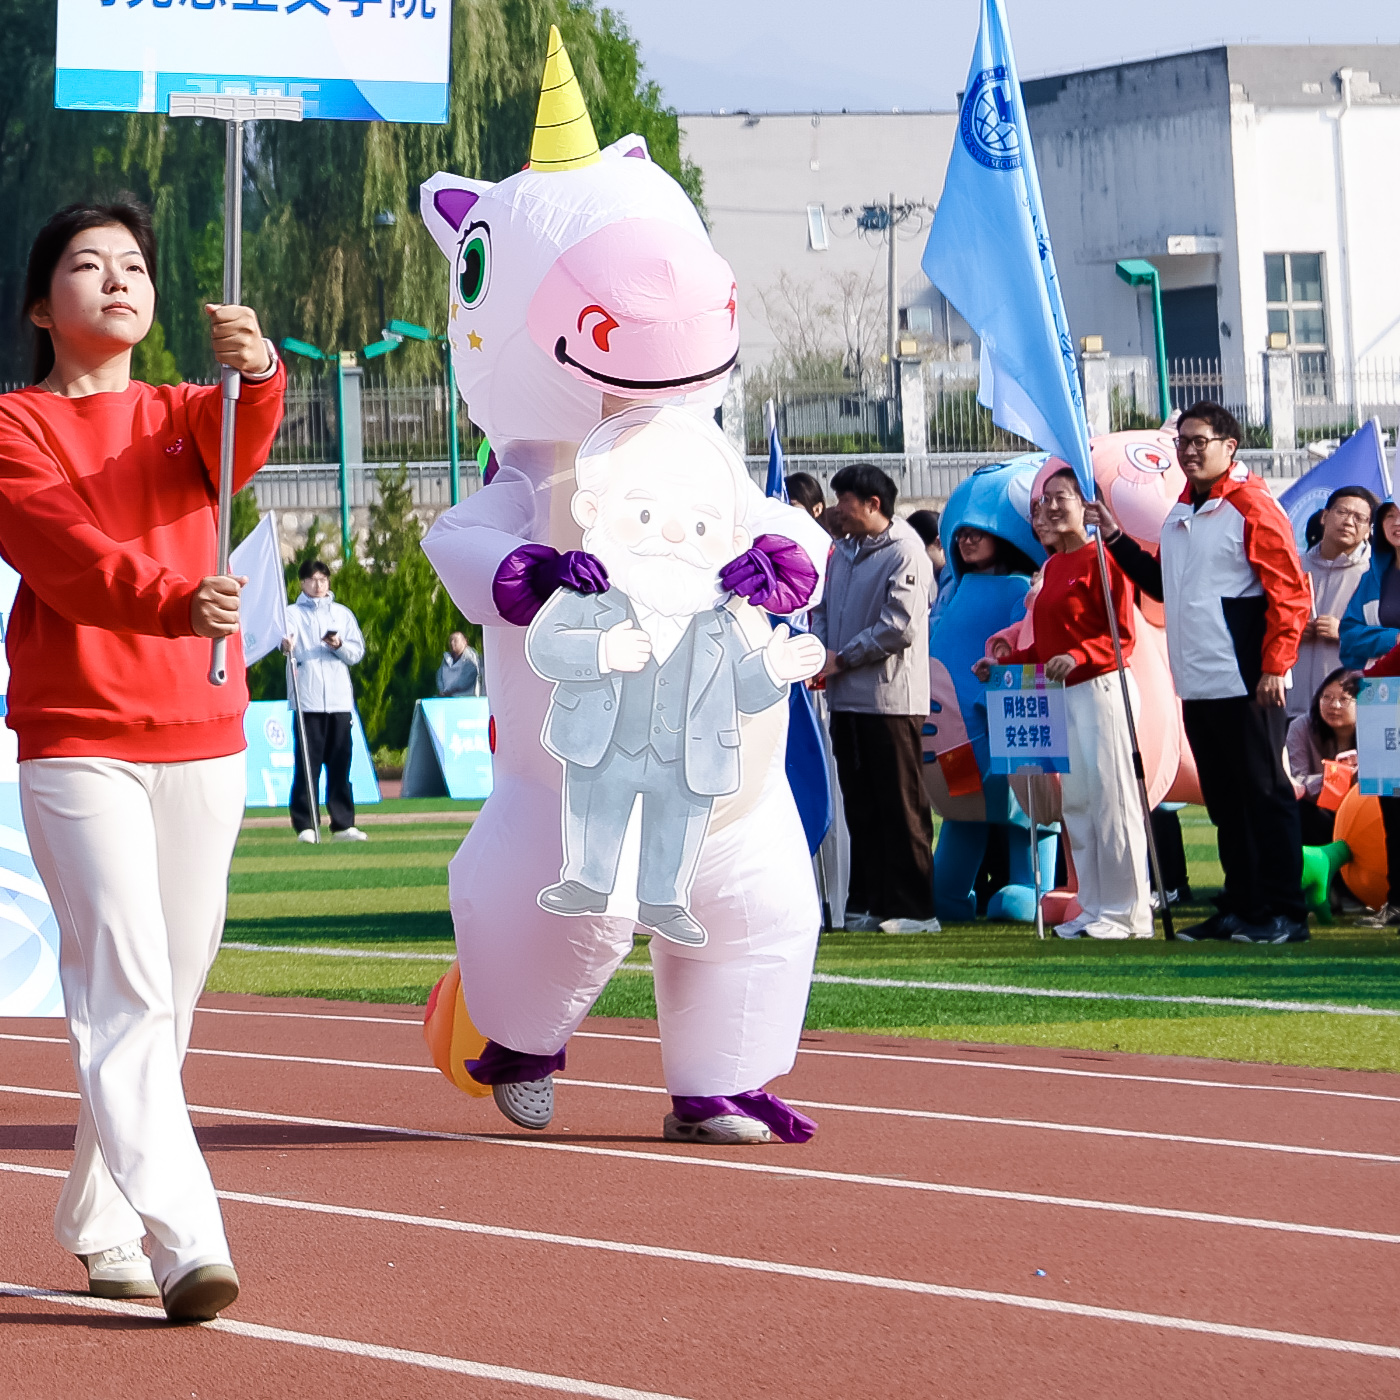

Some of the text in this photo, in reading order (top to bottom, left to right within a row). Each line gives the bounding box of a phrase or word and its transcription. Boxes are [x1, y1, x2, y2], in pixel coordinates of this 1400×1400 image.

[1003, 695, 1050, 719] 网络空间
[1005, 724, 1052, 748] 安全学院
